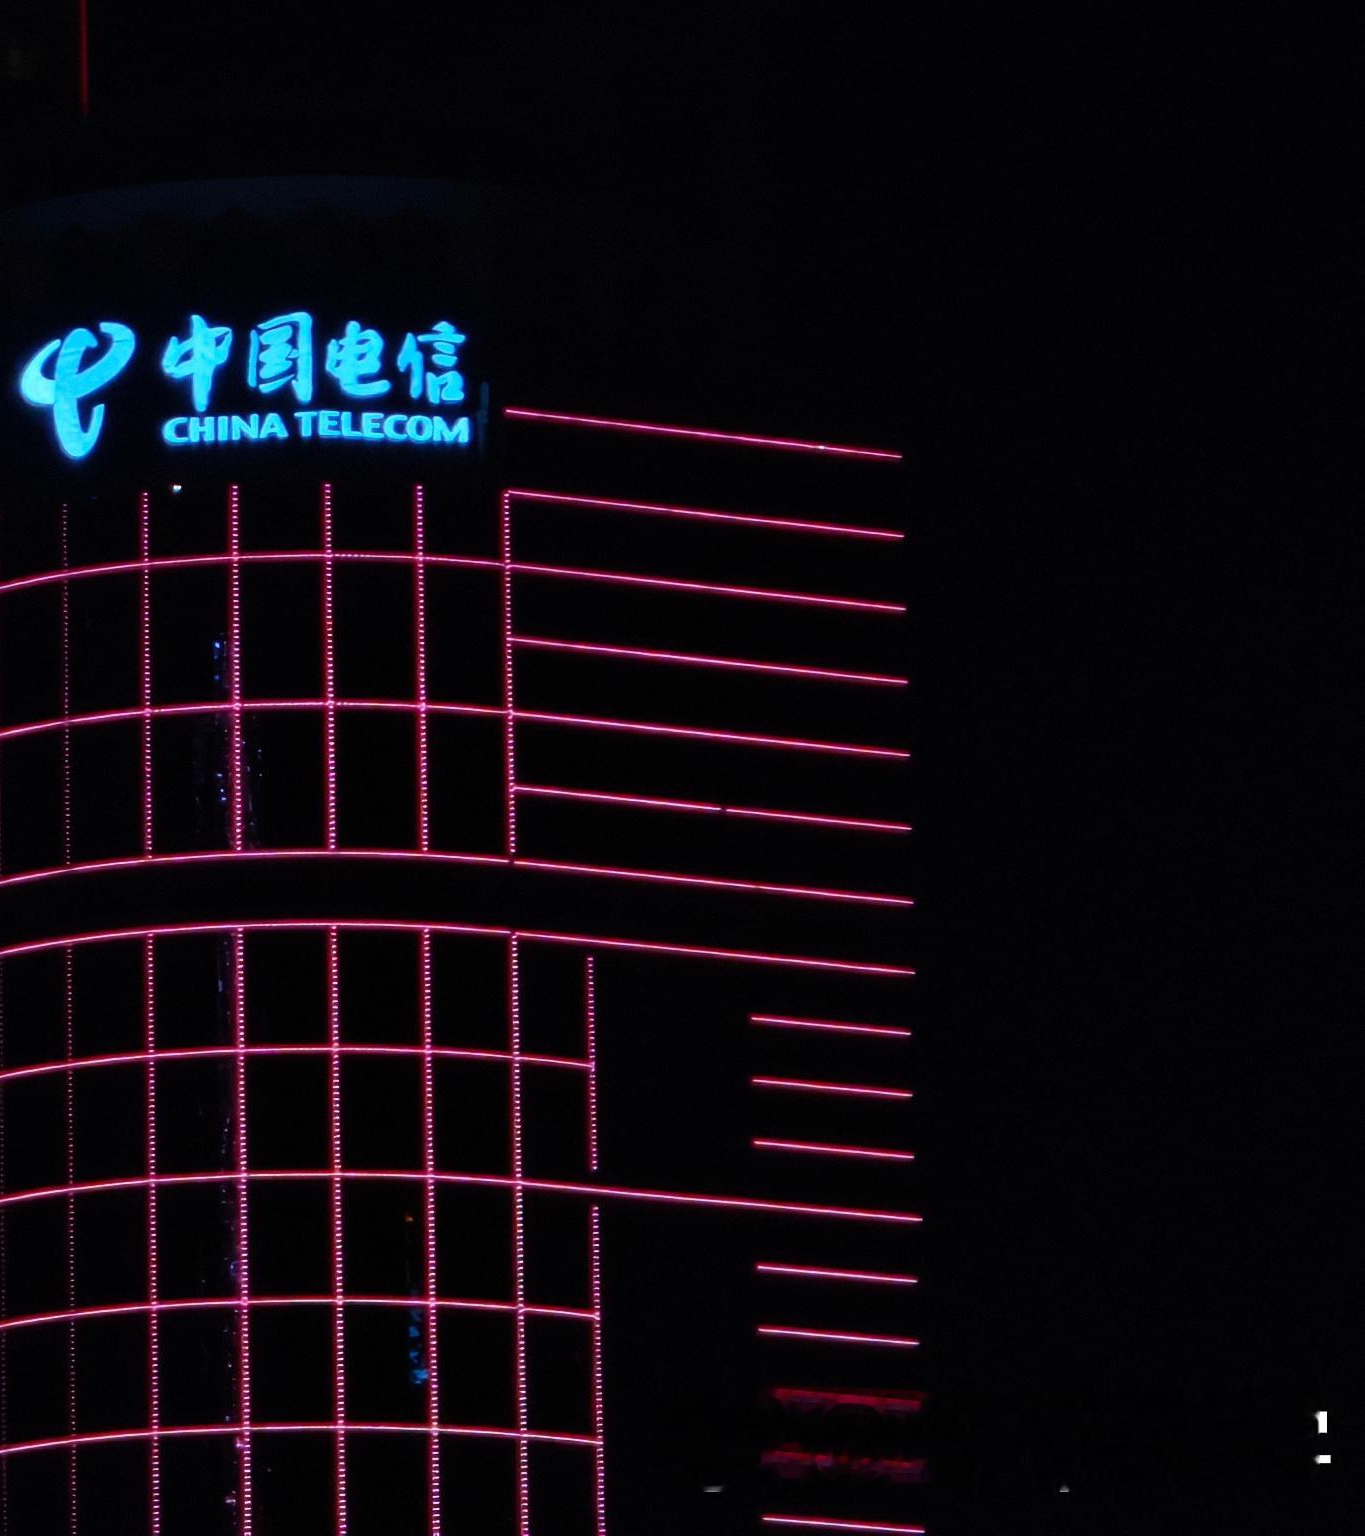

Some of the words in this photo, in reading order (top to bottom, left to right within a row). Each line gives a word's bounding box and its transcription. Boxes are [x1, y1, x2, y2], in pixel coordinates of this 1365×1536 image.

[159, 311, 468, 412] 中国电信
[160, 413, 290, 446] CHINA
[293, 411, 472, 446] TELECOM
